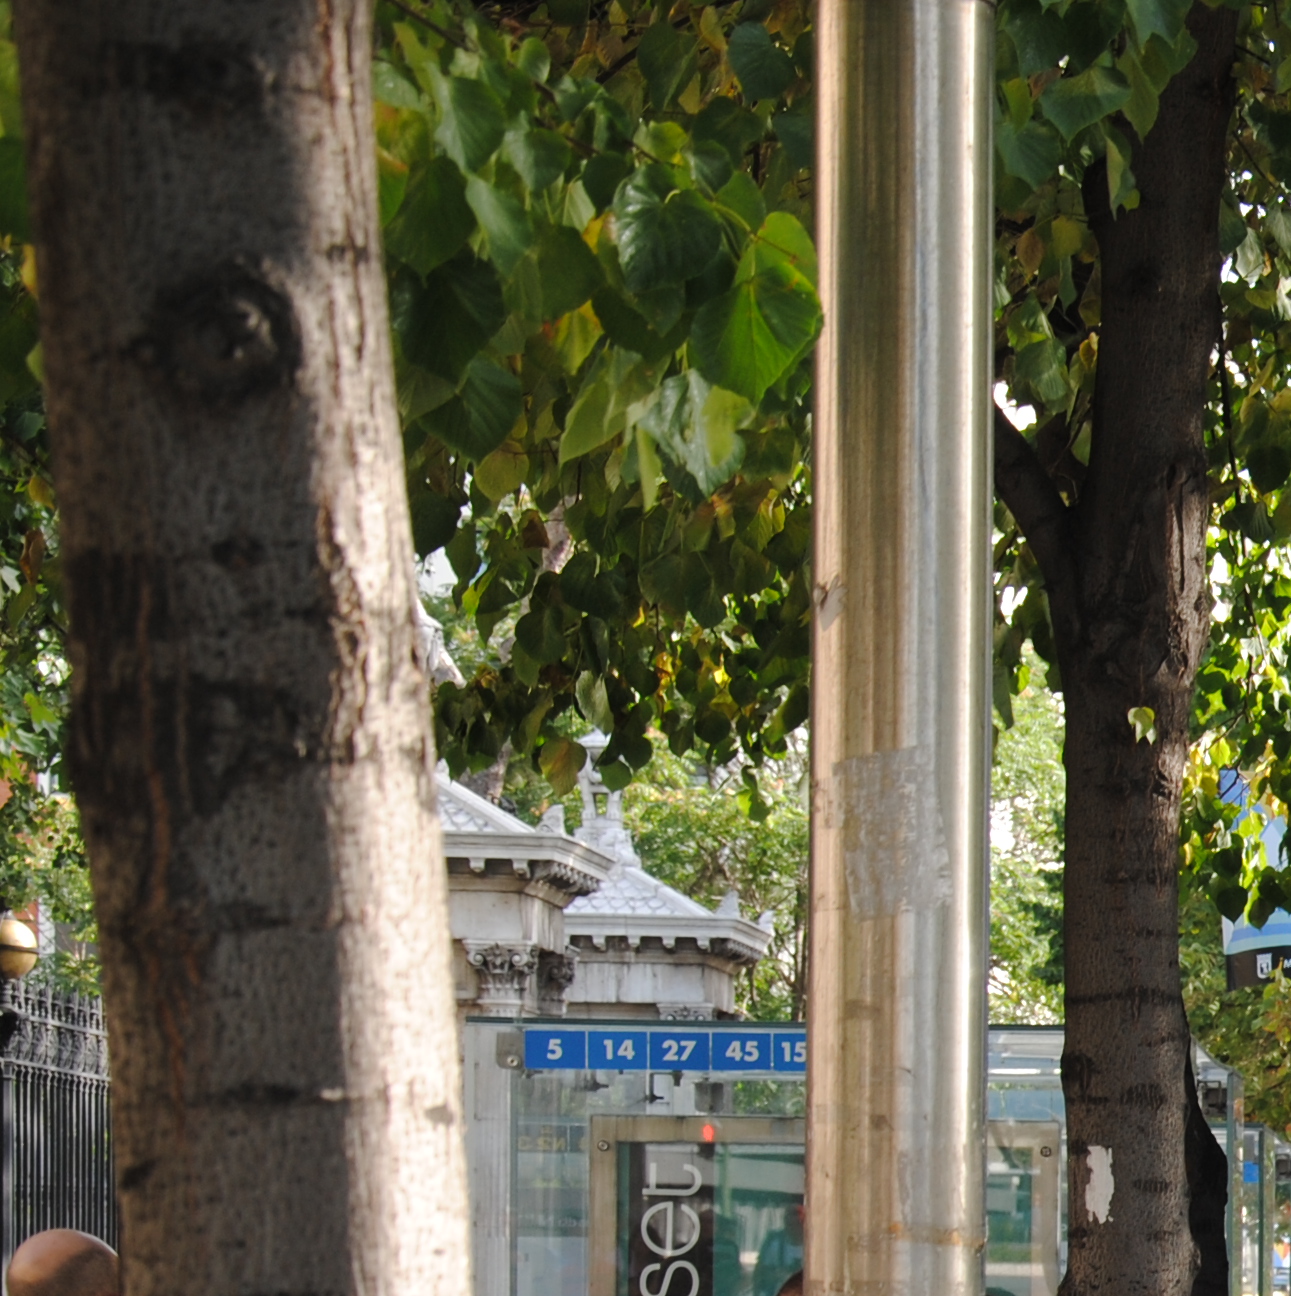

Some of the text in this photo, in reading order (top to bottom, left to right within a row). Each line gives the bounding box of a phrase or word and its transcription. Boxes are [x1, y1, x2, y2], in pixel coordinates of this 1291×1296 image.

[546, 1038, 807, 1063] 5 14 27 45 15
